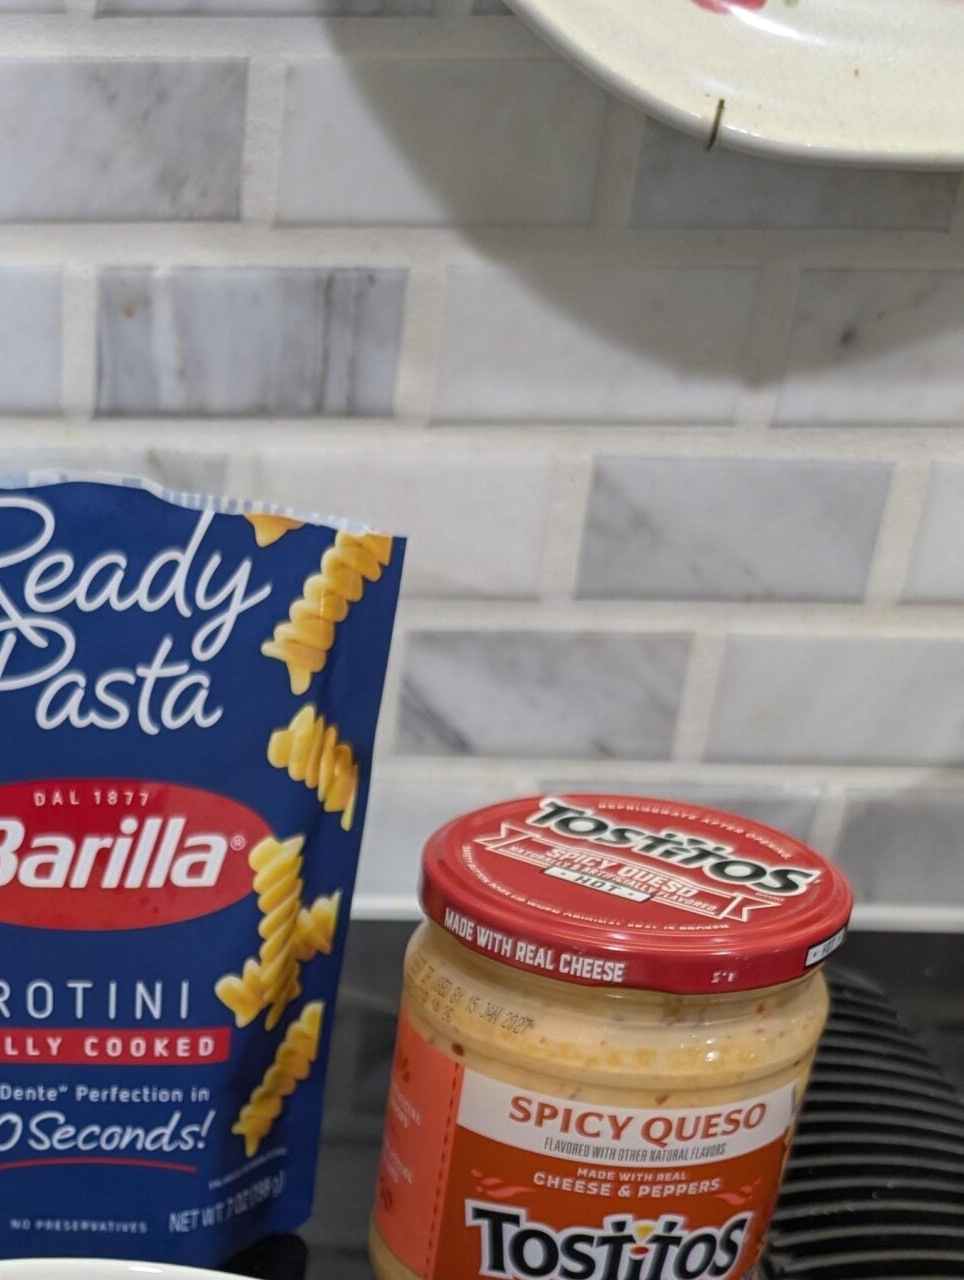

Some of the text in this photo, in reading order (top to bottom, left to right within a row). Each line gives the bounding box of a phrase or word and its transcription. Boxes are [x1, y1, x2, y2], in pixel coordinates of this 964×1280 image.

[35, 791, 150, 806] DAL 1877
[545, 848, 701, 898] SPICY QUESO
[575, 874, 624, 894] HOT
[444, 908, 626, 983] MADE WITH REAL CHEESE
[84, 1036, 217, 1058] COOKED
[76, 1085, 183, 1102] Perfection
[191, 1087, 210, 1102] in
[26, 1108, 217, 1152] Seconds!
[508, 1096, 767, 1148] SPICY QUESO
[544, 1136, 727, 1162] FLAVORED WITH OTHER NATURAL FLAVORS
[533, 1171, 722, 1199] CHEESE & PEPPERS
[577, 1167, 688, 1182] MADE WITH REAL
[10, 1218, 148, 1234] NO PRESERVATIVES
[169, 1208, 200, 1233] NET
